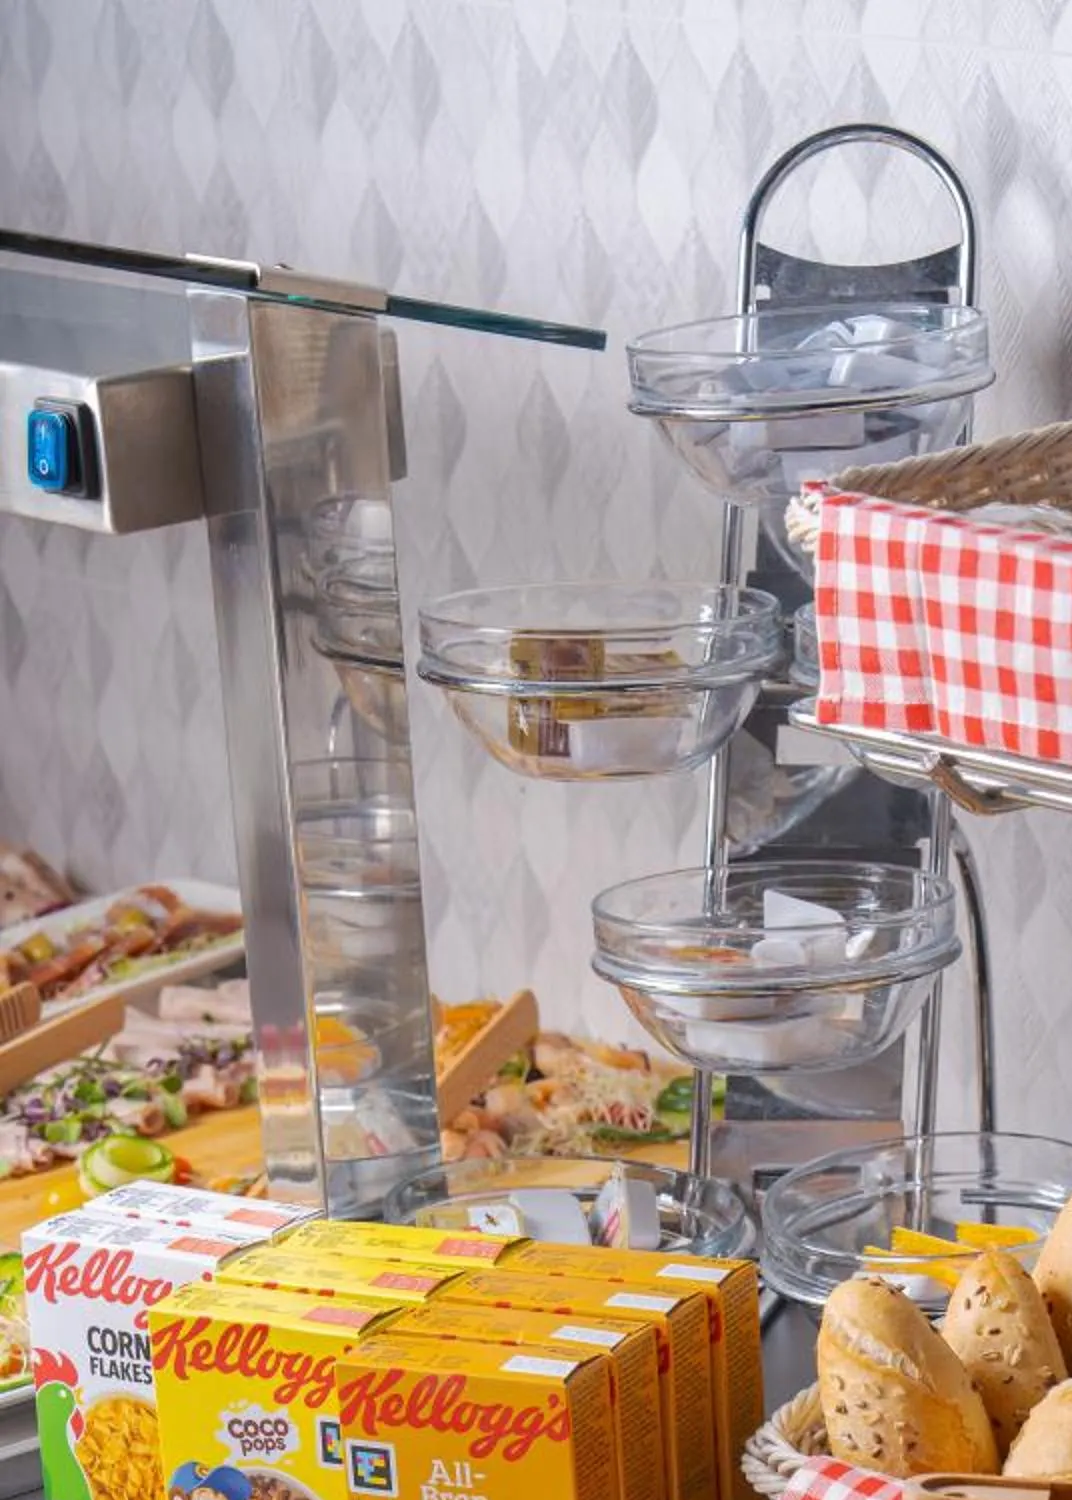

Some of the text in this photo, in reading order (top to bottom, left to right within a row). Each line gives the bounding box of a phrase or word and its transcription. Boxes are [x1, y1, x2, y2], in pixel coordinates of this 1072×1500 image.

[87, 1326, 151, 1361] CORN
[89, 1357, 153, 1385] FLAKES
[152, 1317, 336, 1408] Kellogg
[338, 1368, 571, 1462] Kellogg's
[240, 1438, 287, 1456] pops
[428, 1459, 487, 1488] All-
